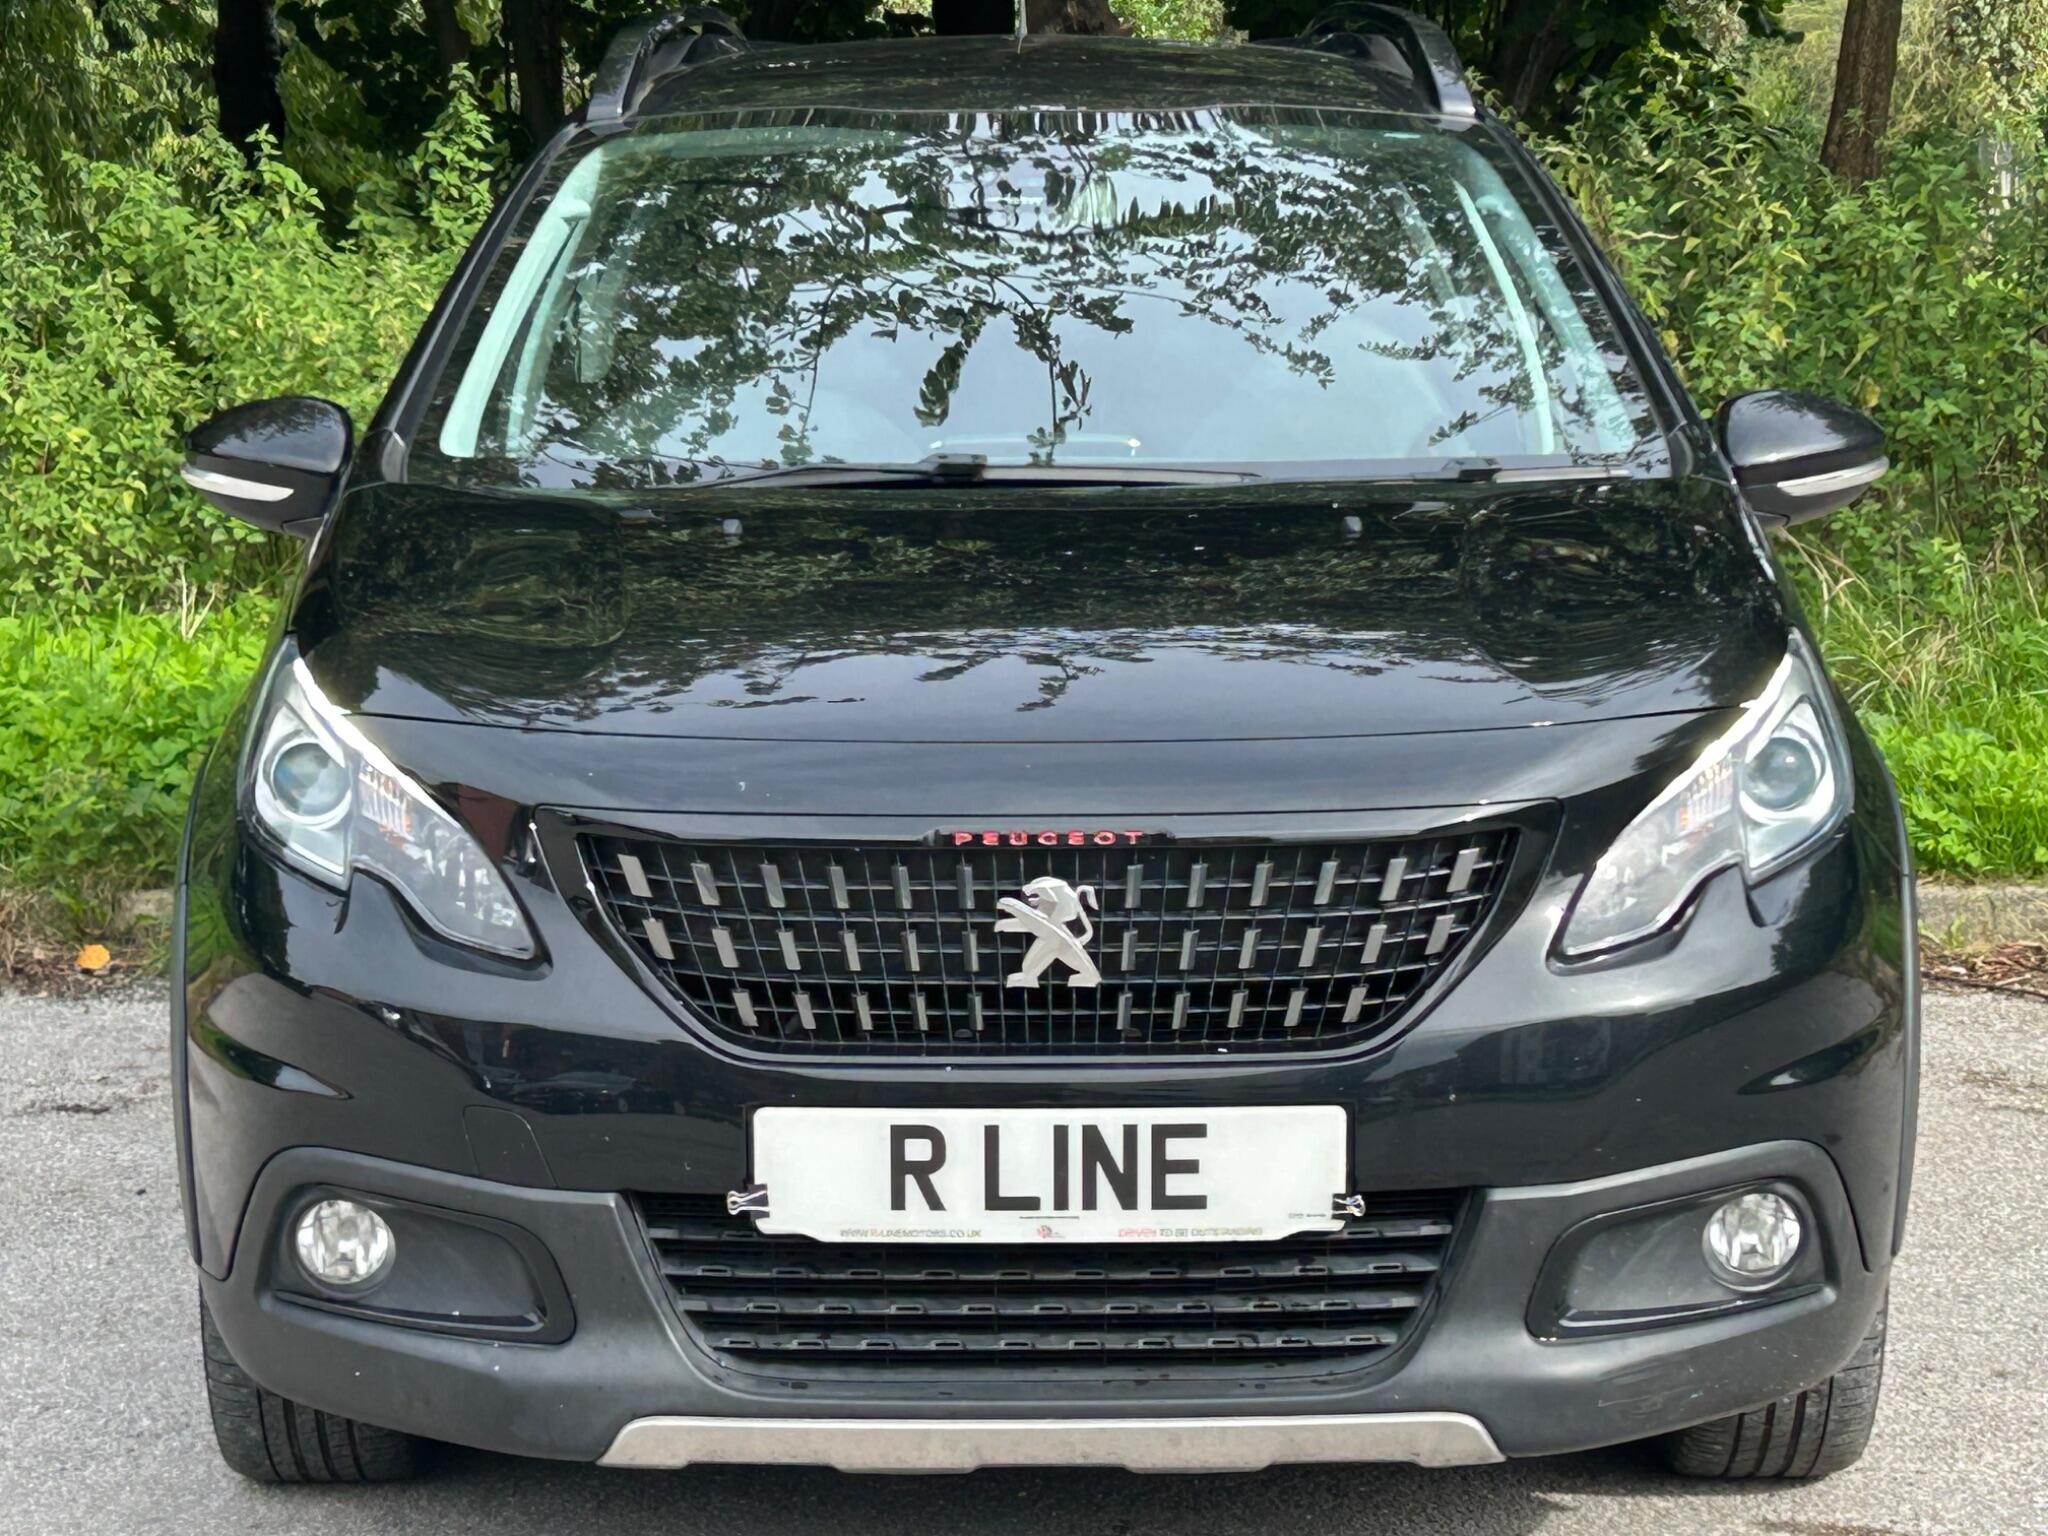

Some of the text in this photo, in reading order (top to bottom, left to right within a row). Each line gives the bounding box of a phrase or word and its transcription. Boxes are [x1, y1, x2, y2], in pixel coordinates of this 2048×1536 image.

[952, 830, 1143, 846] PEUGEOT
[890, 1123, 1208, 1211] R LINE
